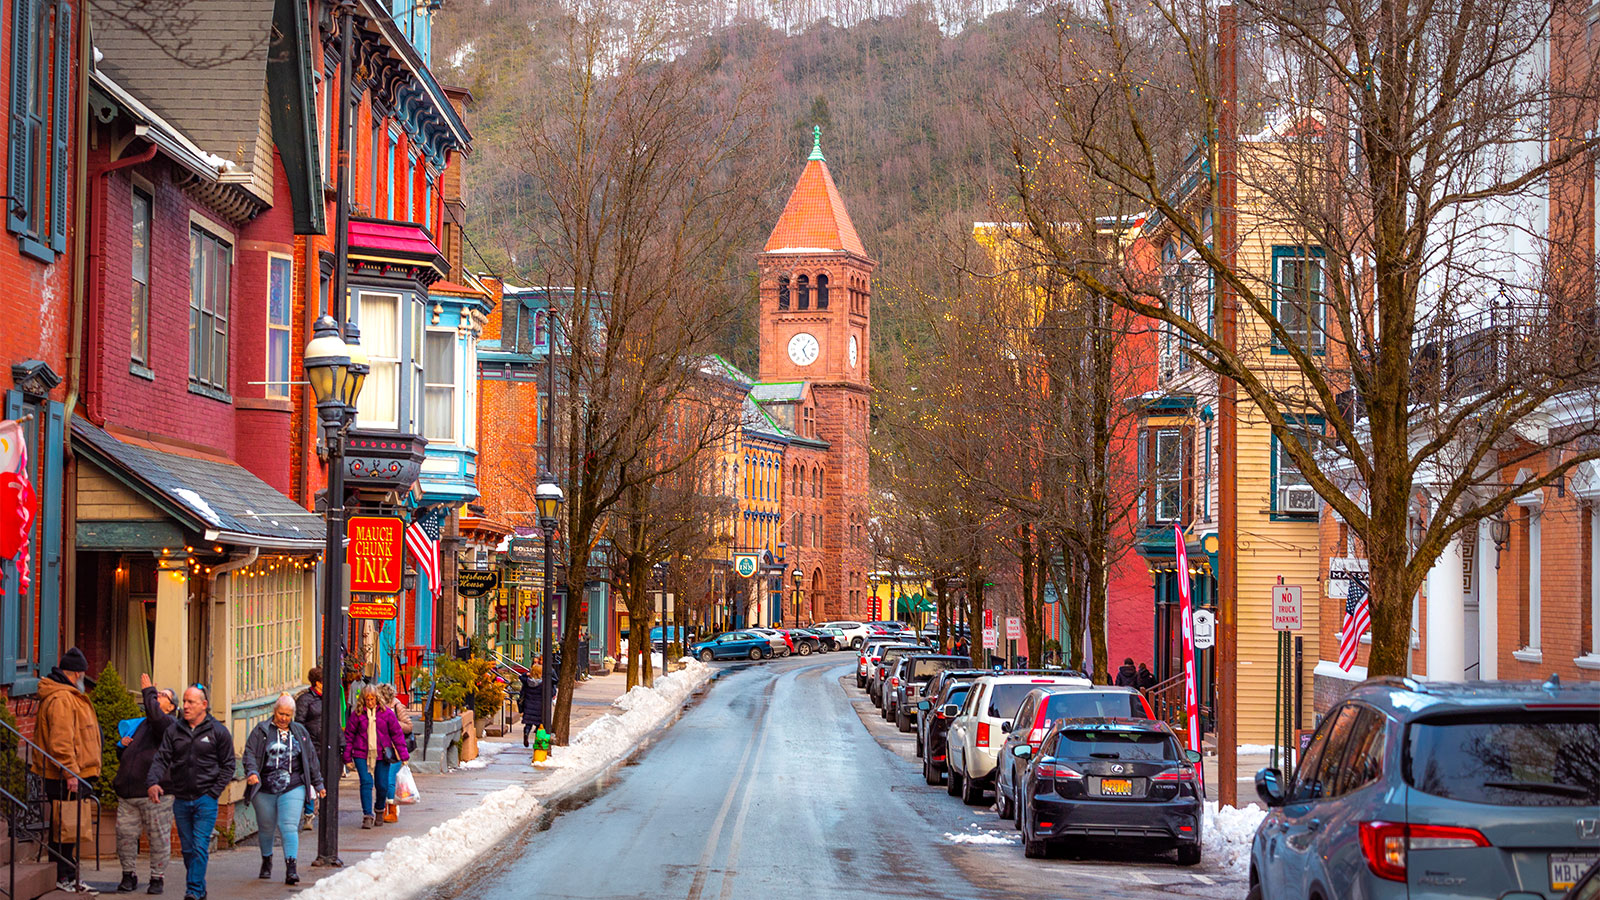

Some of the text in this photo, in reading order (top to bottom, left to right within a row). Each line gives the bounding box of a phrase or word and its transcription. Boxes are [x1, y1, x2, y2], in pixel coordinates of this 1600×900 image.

[356, 526, 393, 541] MAUCH
[355, 541, 393, 556] CHUNK
[355, 557, 392, 583] INK
[459, 579, 484, 588] House
[1281, 592, 1292, 603] NO
[1278, 605, 1296, 613] TRUCK
[1275, 615, 1298, 623] PARKING
